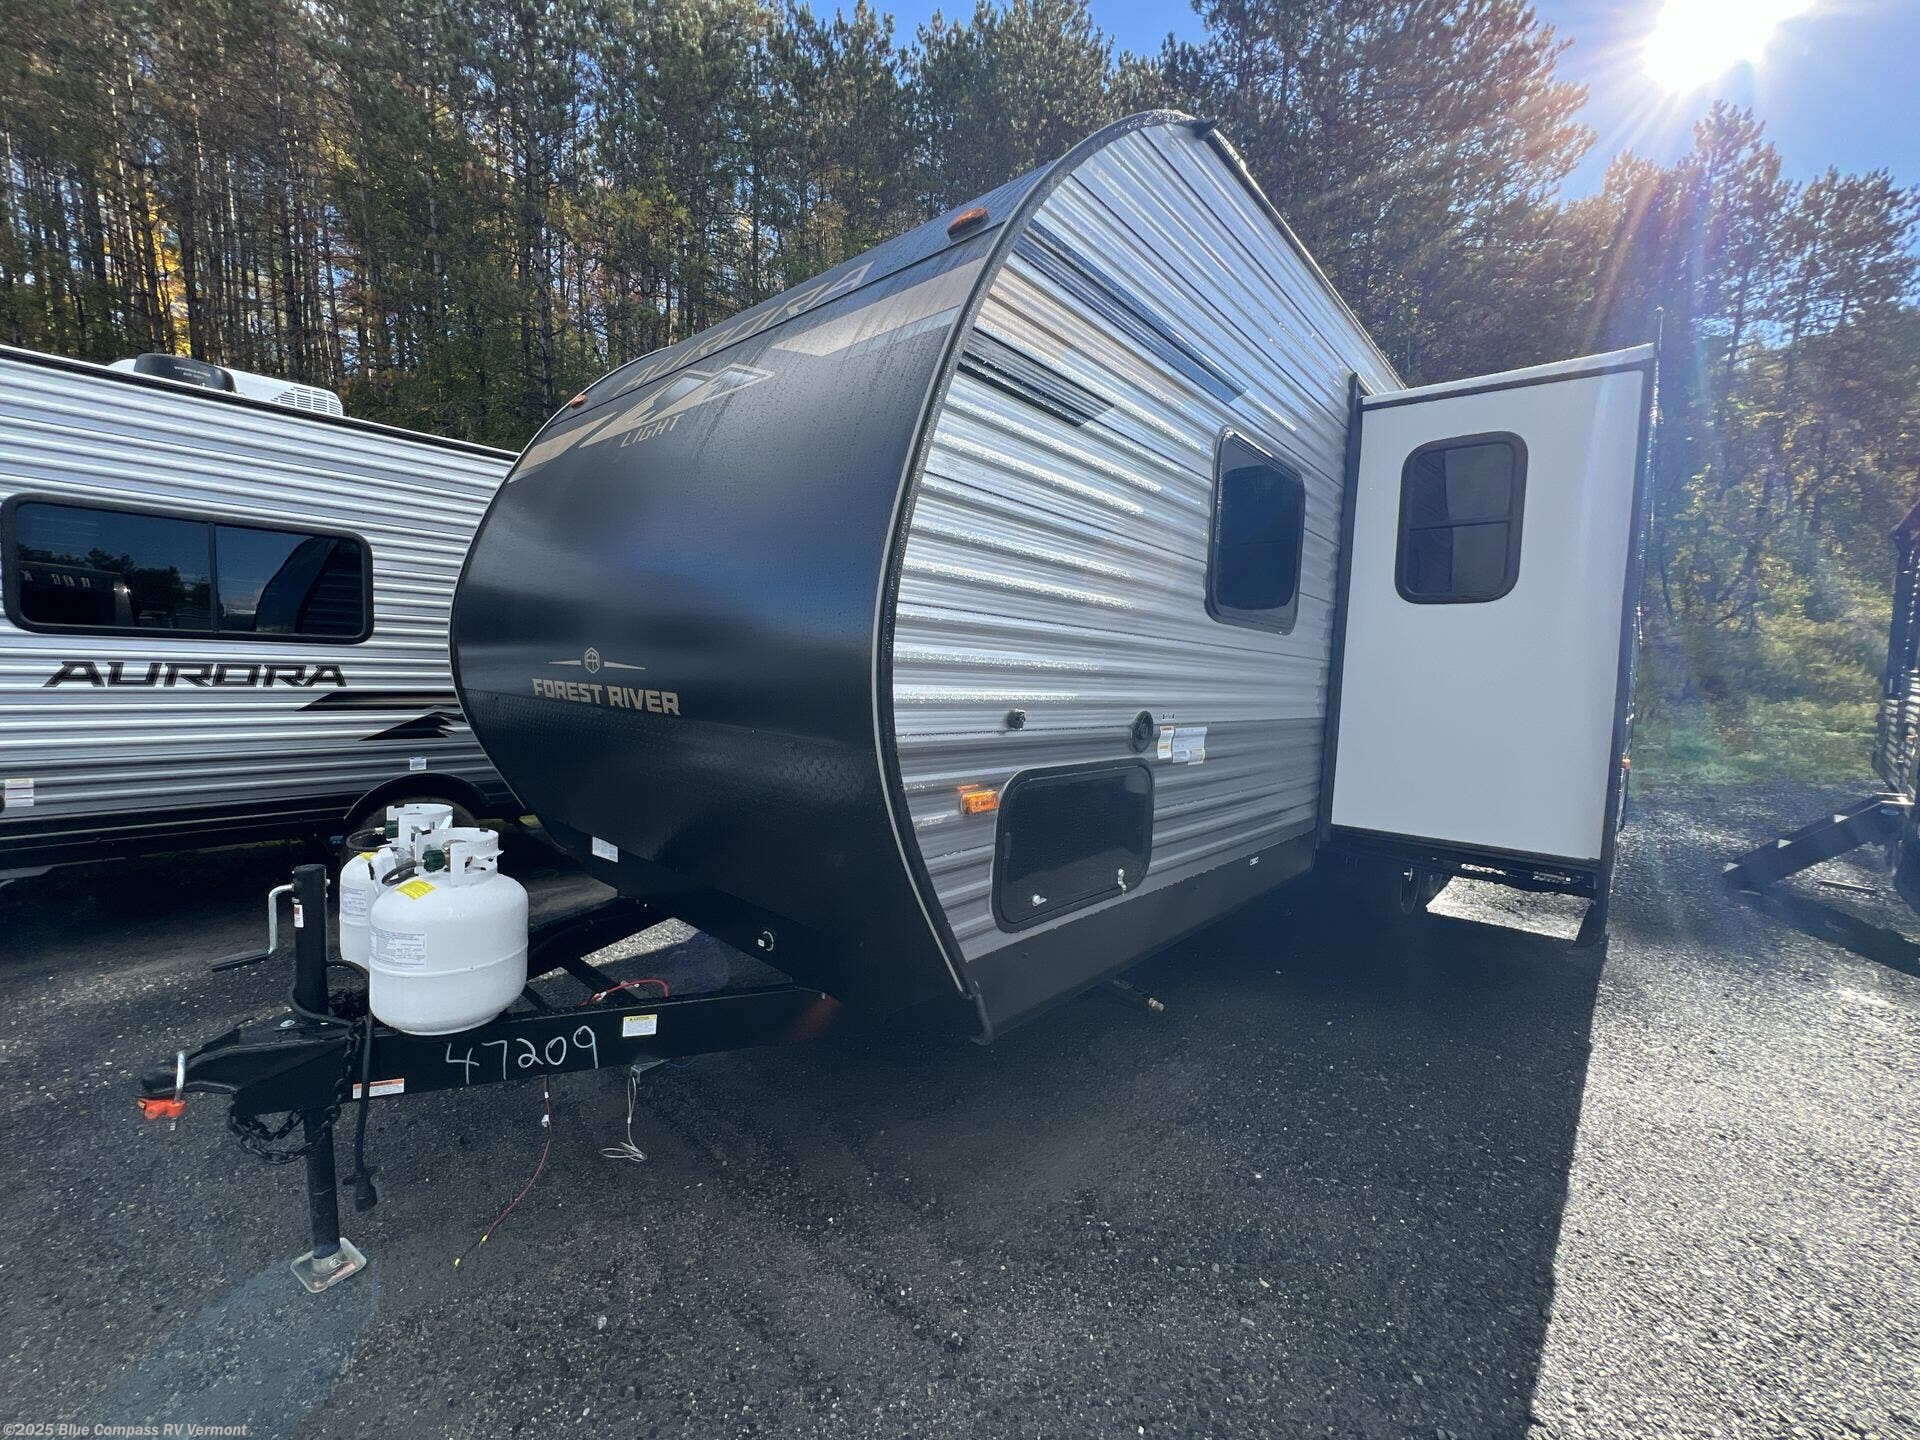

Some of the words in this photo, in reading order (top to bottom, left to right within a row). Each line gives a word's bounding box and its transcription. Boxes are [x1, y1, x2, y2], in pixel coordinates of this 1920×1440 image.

[620, 413, 686, 449] LIGHT
[43, 660, 347, 688] AURORA
[531, 678, 603, 705] FOREST
[606, 685, 681, 716] RIVER
[446, 1025, 599, 1085] 47209
